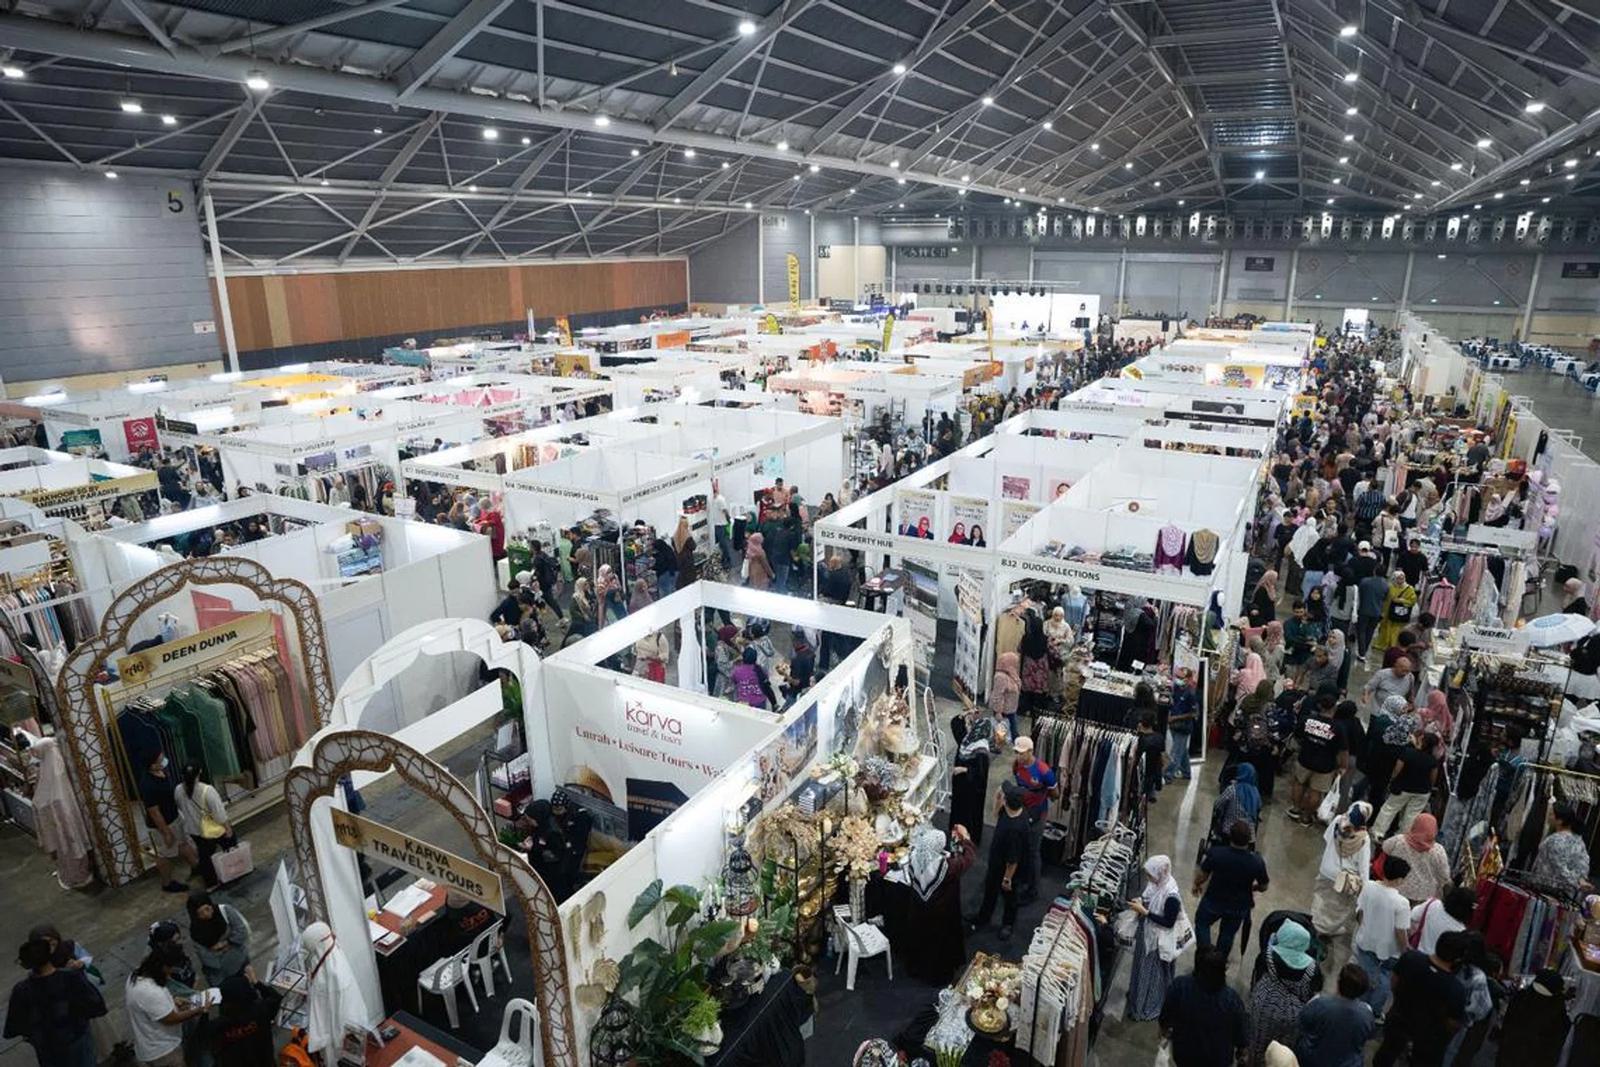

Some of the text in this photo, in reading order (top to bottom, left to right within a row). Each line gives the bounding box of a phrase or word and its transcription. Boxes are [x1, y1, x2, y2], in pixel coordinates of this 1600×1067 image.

[168, 191, 184, 213] 5
[821, 530, 893, 549] B25 PROPERTY HUB
[1022, 562, 1101, 582] DUOCOLLECTIONS
[162, 630, 238, 663] DEEN DUNYA
[625, 700, 683, 736] karva
[627, 724, 649, 738] travel
[618, 739, 658, 761] Leisure
[660, 752, 694, 771] Tours
[372, 839, 484, 897] TRAVEL & TOURS
[404, 839, 450, 868] KARVA
